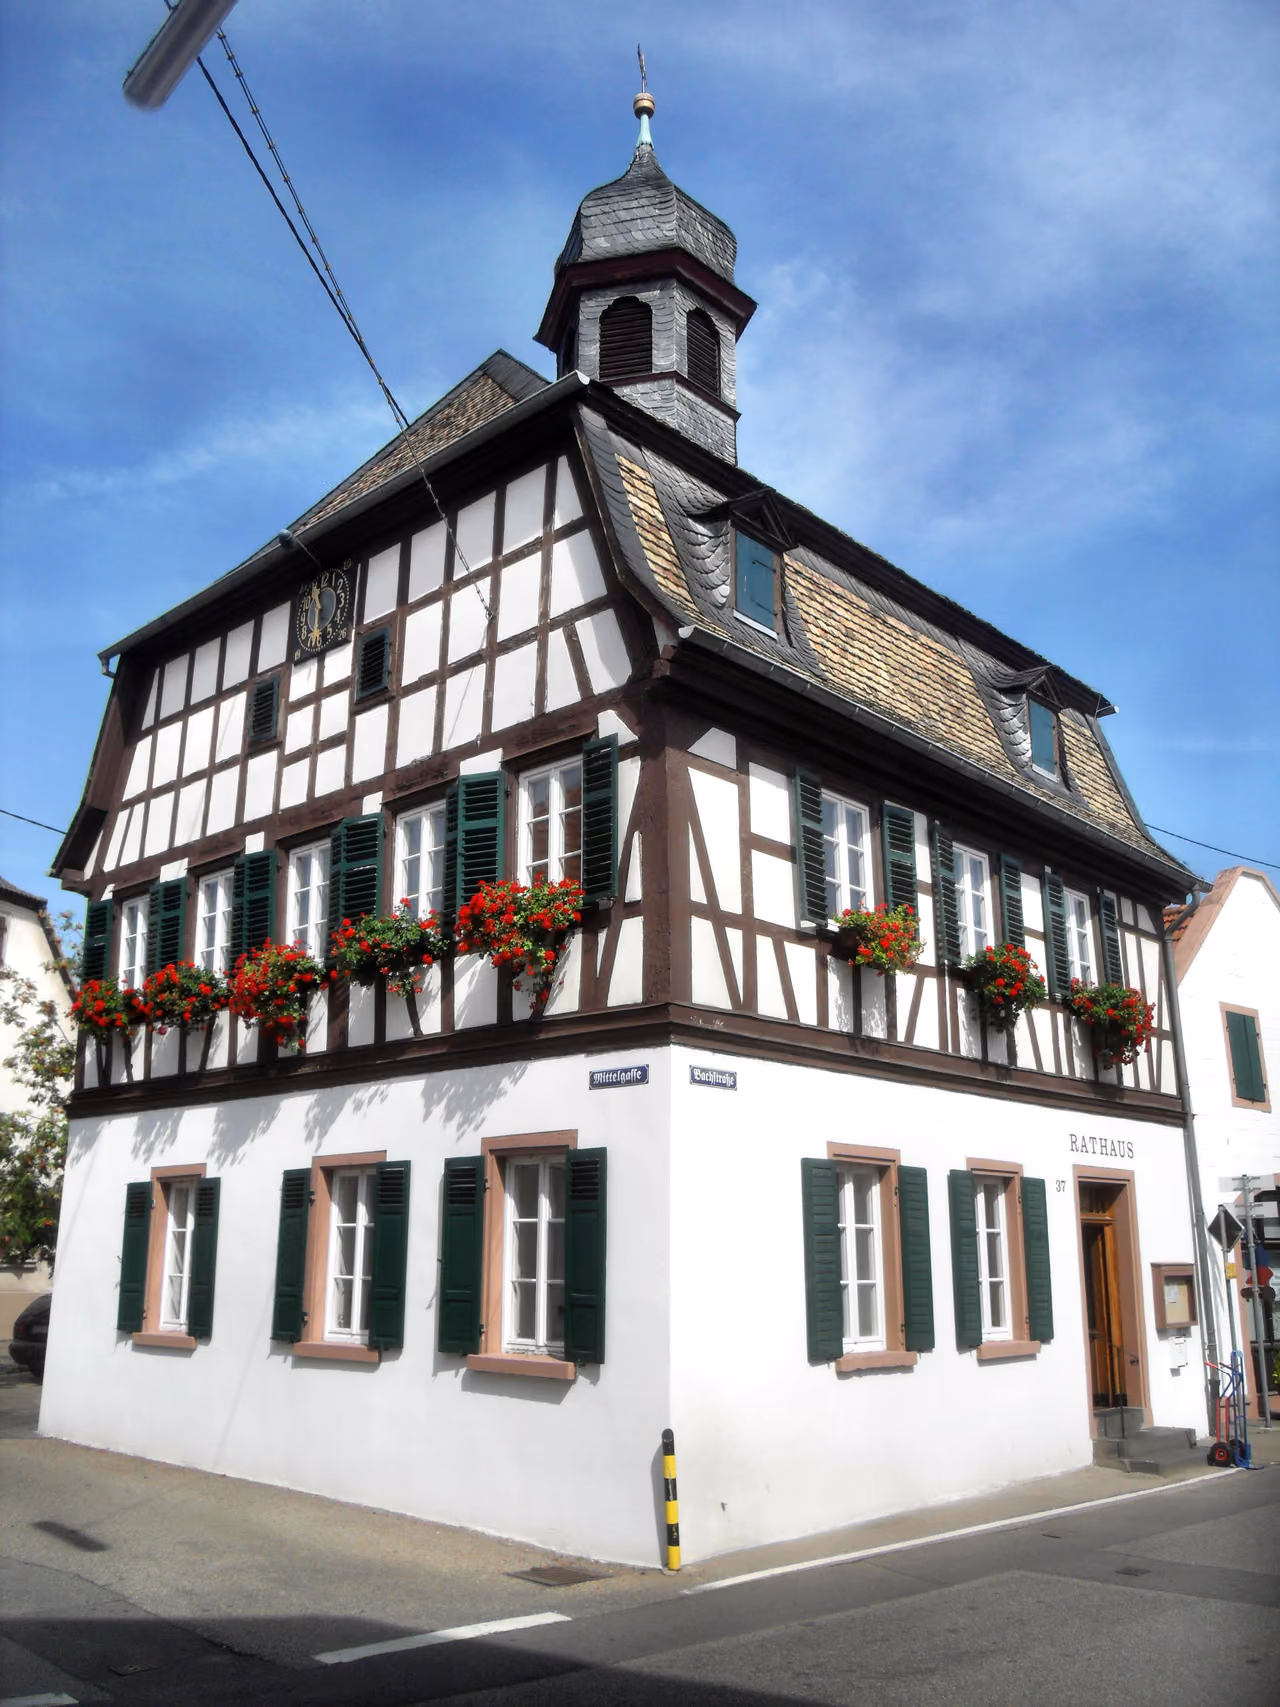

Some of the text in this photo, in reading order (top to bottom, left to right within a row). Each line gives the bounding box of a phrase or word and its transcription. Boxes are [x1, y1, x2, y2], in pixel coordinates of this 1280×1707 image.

[321, 572, 330, 588] 12
[337, 579, 344, 594] 2
[339, 593, 345, 608] 3
[300, 612, 306, 626] 9
[335, 610, 341, 624] 4
[301, 626, 307, 640] 8
[327, 624, 333, 639] 5
[1069, 1133, 1134, 1159] RATHAUS
[1055, 1179, 1066, 1193] 37
